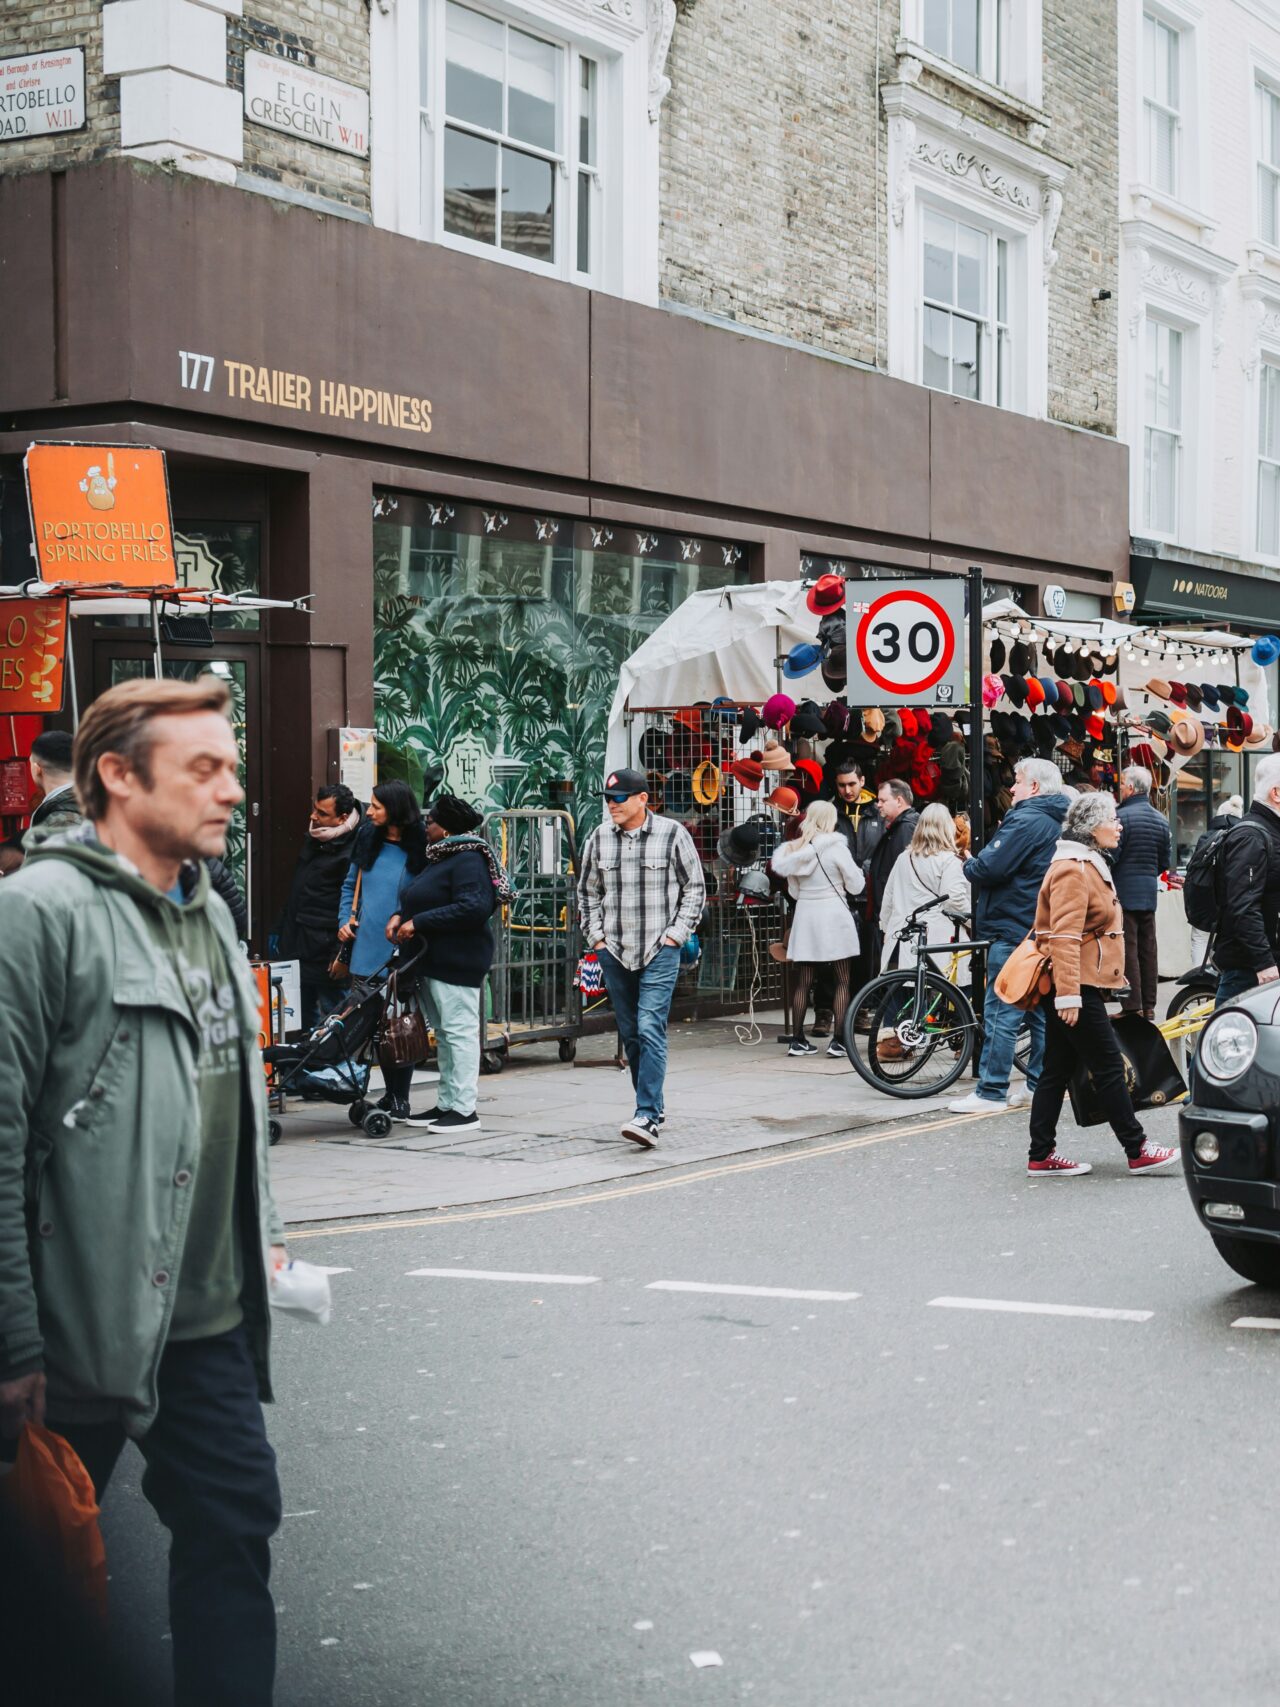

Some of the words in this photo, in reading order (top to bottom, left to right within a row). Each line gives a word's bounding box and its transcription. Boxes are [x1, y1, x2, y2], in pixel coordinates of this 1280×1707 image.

[277, 81, 341, 121] ELGIN
[178, 350, 215, 393] 177
[223, 359, 311, 412] TRAILER
[319, 379, 433, 434] HAPPINESS
[43, 522, 166, 541] PORTOBELLO
[46, 545, 117, 563] SPRING
[121, 545, 169, 563] FRIES
[1193, 582, 1230, 600] NATOORA
[872, 621, 940, 664] 30
